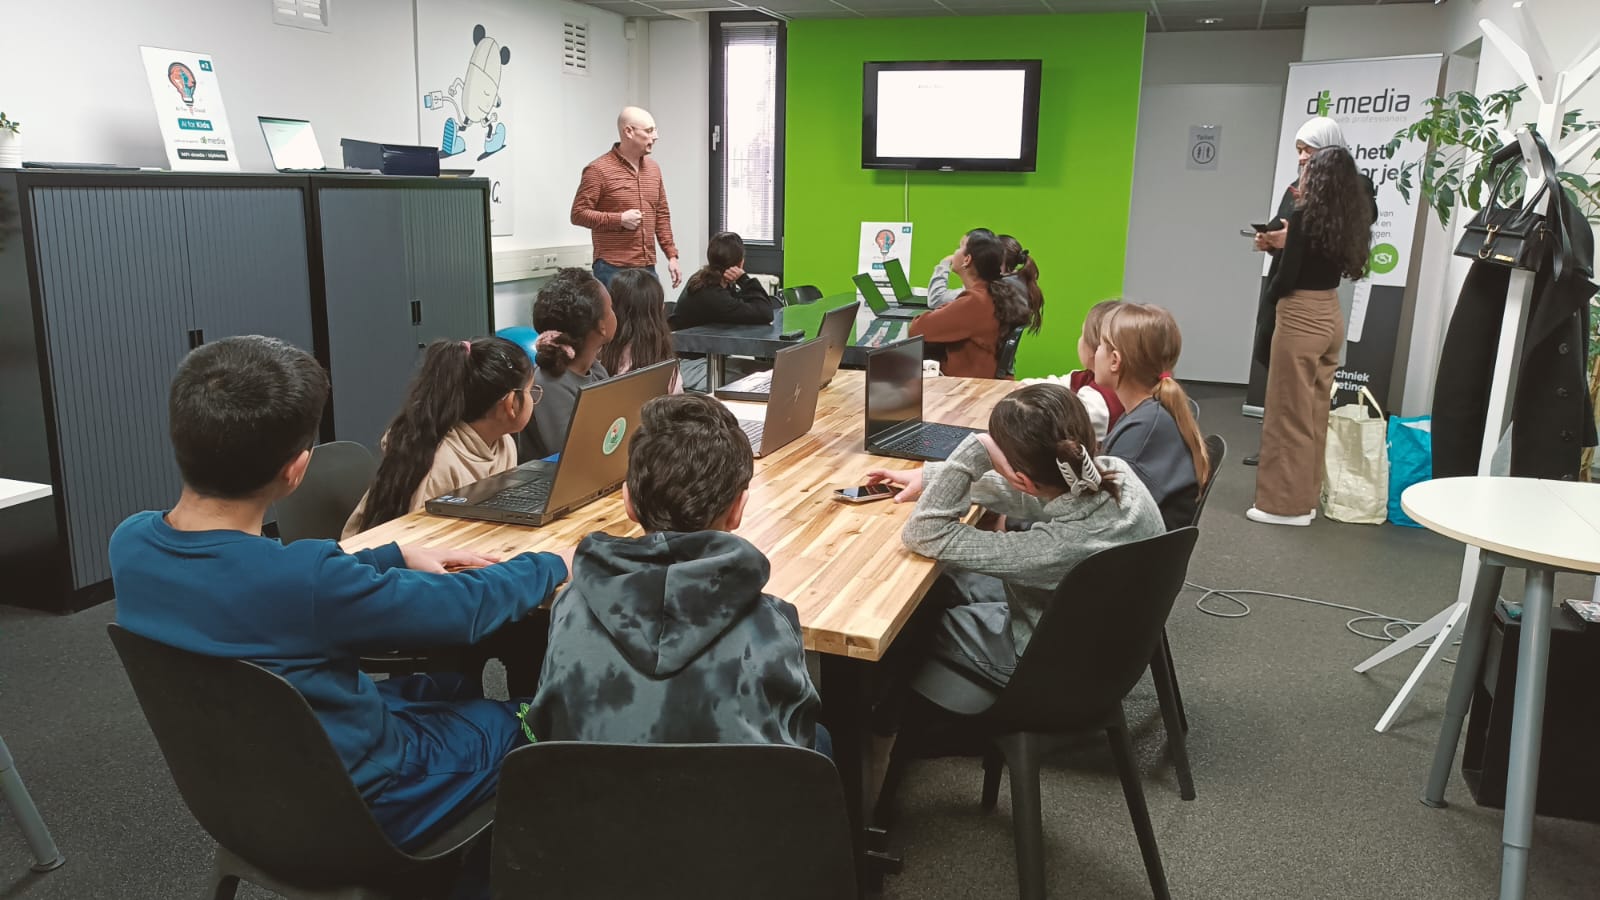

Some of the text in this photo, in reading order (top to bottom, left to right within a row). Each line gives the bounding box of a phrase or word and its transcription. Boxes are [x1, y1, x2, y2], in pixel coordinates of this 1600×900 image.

[196, 121, 211, 129] Kids
[1355, 144, 1387, 159] het
[1379, 164, 1399, 185] je
[1380, 210, 1394, 218] van
[1336, 369, 1370, 382] chniek
